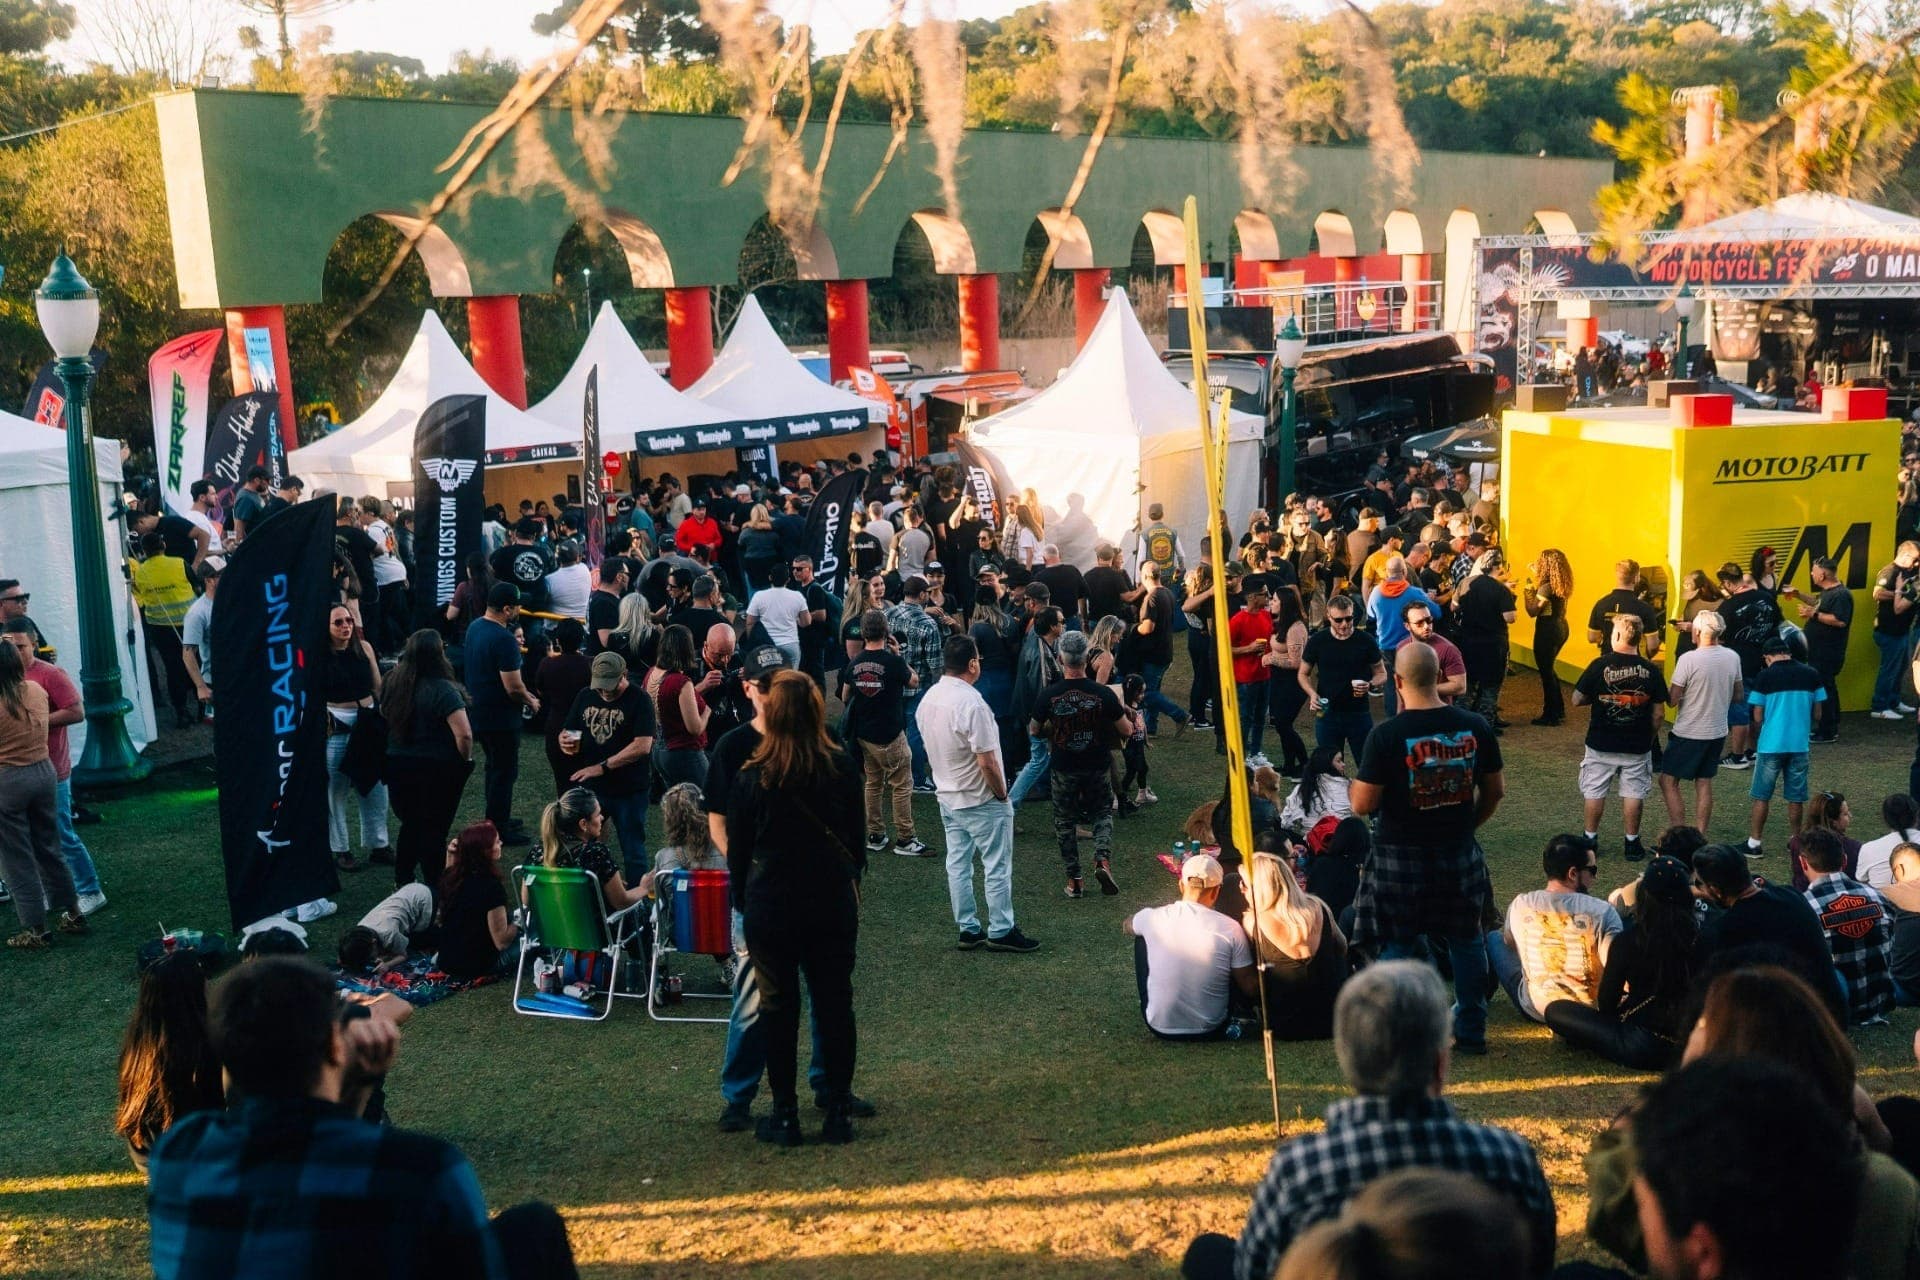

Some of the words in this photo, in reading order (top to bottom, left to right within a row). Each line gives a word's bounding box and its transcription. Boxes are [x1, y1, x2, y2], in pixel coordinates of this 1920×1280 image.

[1776, 257, 1823, 279] FET
[1208, 375, 1228, 386] HOW
[1713, 453, 1872, 485] MOTOBATT
[438, 497, 457, 557] CUSTOM
[436, 559, 457, 606] WINGS
[264, 573, 297, 735] RACING
[1834, 899, 1863, 911] MOTOR
[1842, 919, 1872, 934] CYCLES
